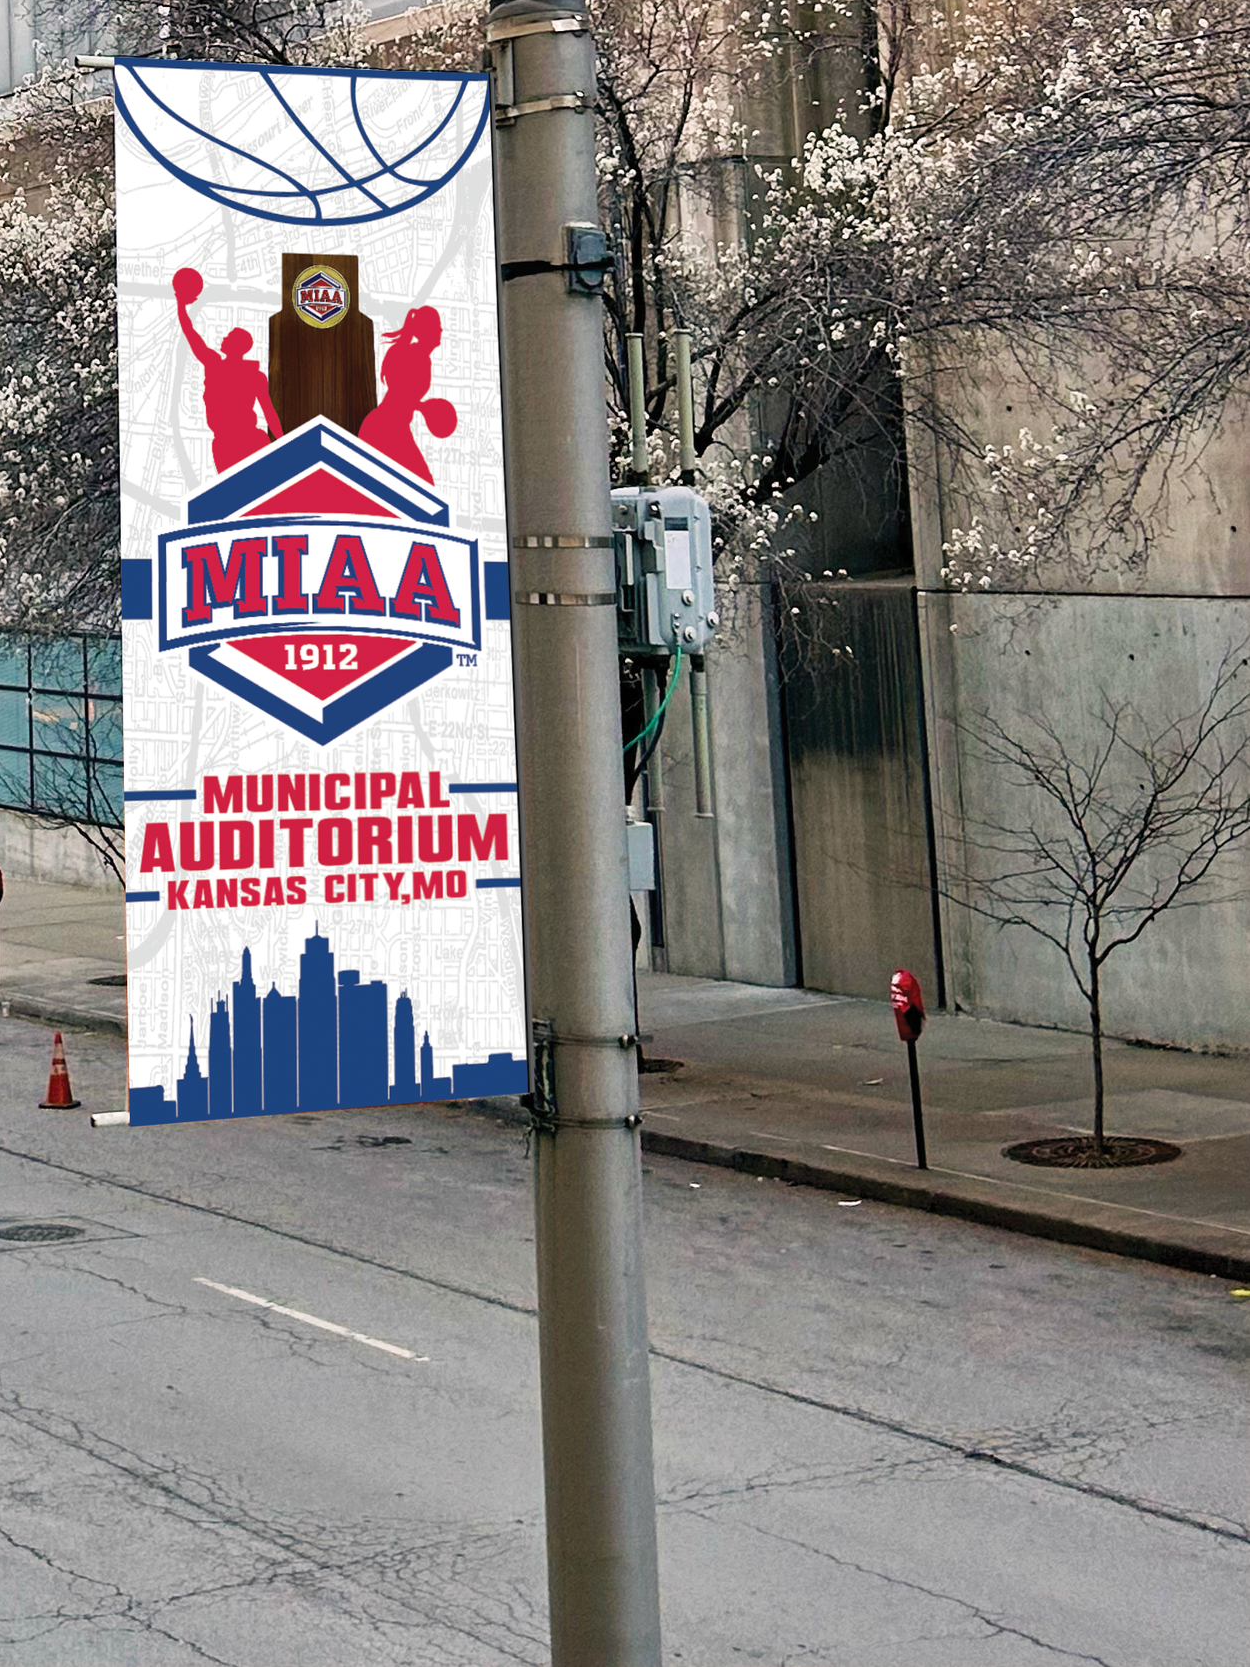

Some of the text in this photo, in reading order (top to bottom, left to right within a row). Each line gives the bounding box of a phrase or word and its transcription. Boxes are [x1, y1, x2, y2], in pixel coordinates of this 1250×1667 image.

[395, 103, 424, 136] Front
[300, 288, 343, 306] MIAA
[448, 306, 460, 375] Virginia
[151, 416, 168, 461] Bluff
[180, 535, 462, 630] MIAA
[285, 643, 359, 672] 1912
[455, 653, 479, 668] TM
[202, 770, 451, 814] MUNICIPAL
[139, 812, 509, 874] AUDITORIUM
[167, 875, 307, 911] KANSAS
[434, 943, 465, 962] Lake
[136, 981, 148, 1049] Jarboe
[157, 967, 170, 1051] Madison
